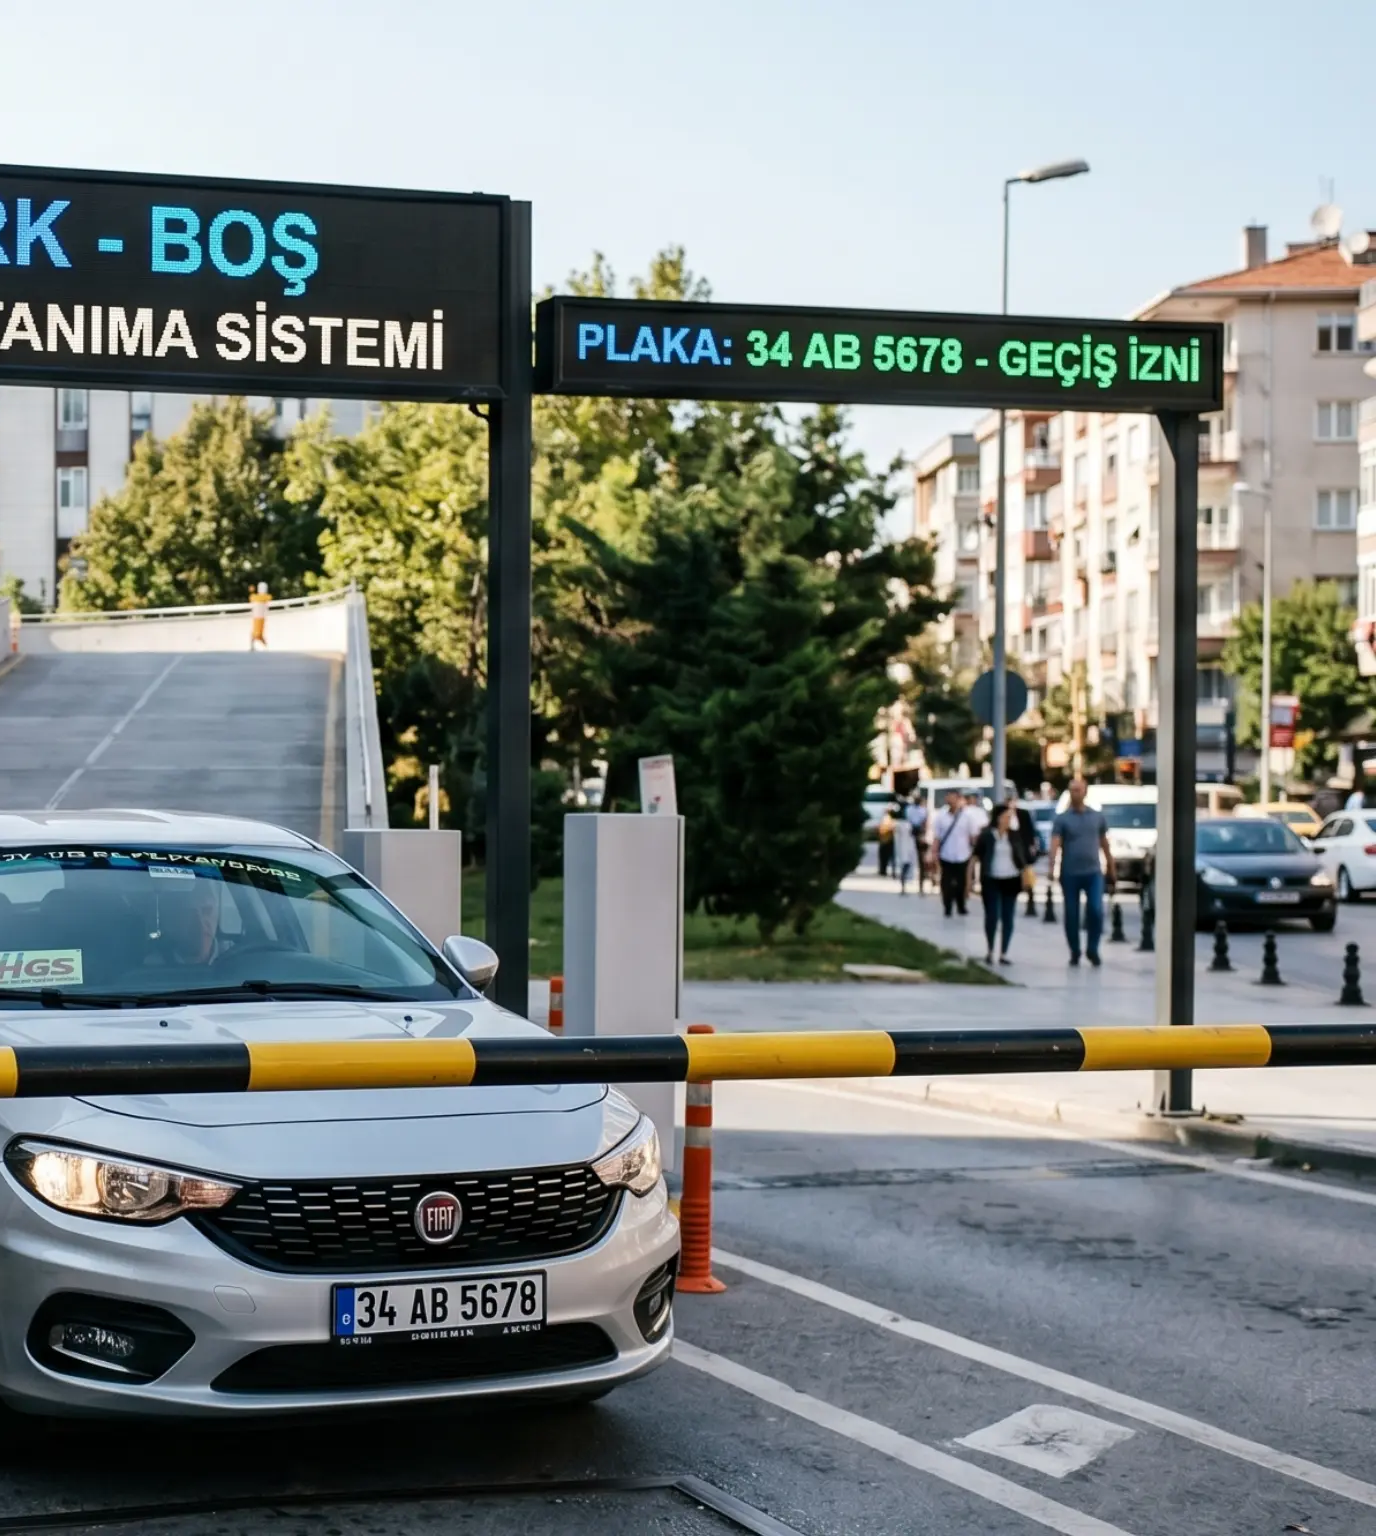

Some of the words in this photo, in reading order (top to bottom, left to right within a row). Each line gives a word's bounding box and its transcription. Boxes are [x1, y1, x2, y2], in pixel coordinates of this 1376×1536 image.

[98, 238, 124, 253] -
[151, 205, 319, 297] BOŞ
[215, 301, 444, 371] SİSTEMİ
[578, 322, 733, 366] PLAKA:
[746, 329, 793, 368] 34
[802, 332, 862, 371] AB
[872, 334, 963, 374] 5678
[998, 334, 1118, 389] GEÇİŞ
[1128, 335, 1200, 383] İZNİ
[427, 1206, 454, 1232] FIAT
[357, 1291, 397, 1329] 34
[410, 1287, 449, 1325] AB
[460, 1279, 537, 1321] 5678
